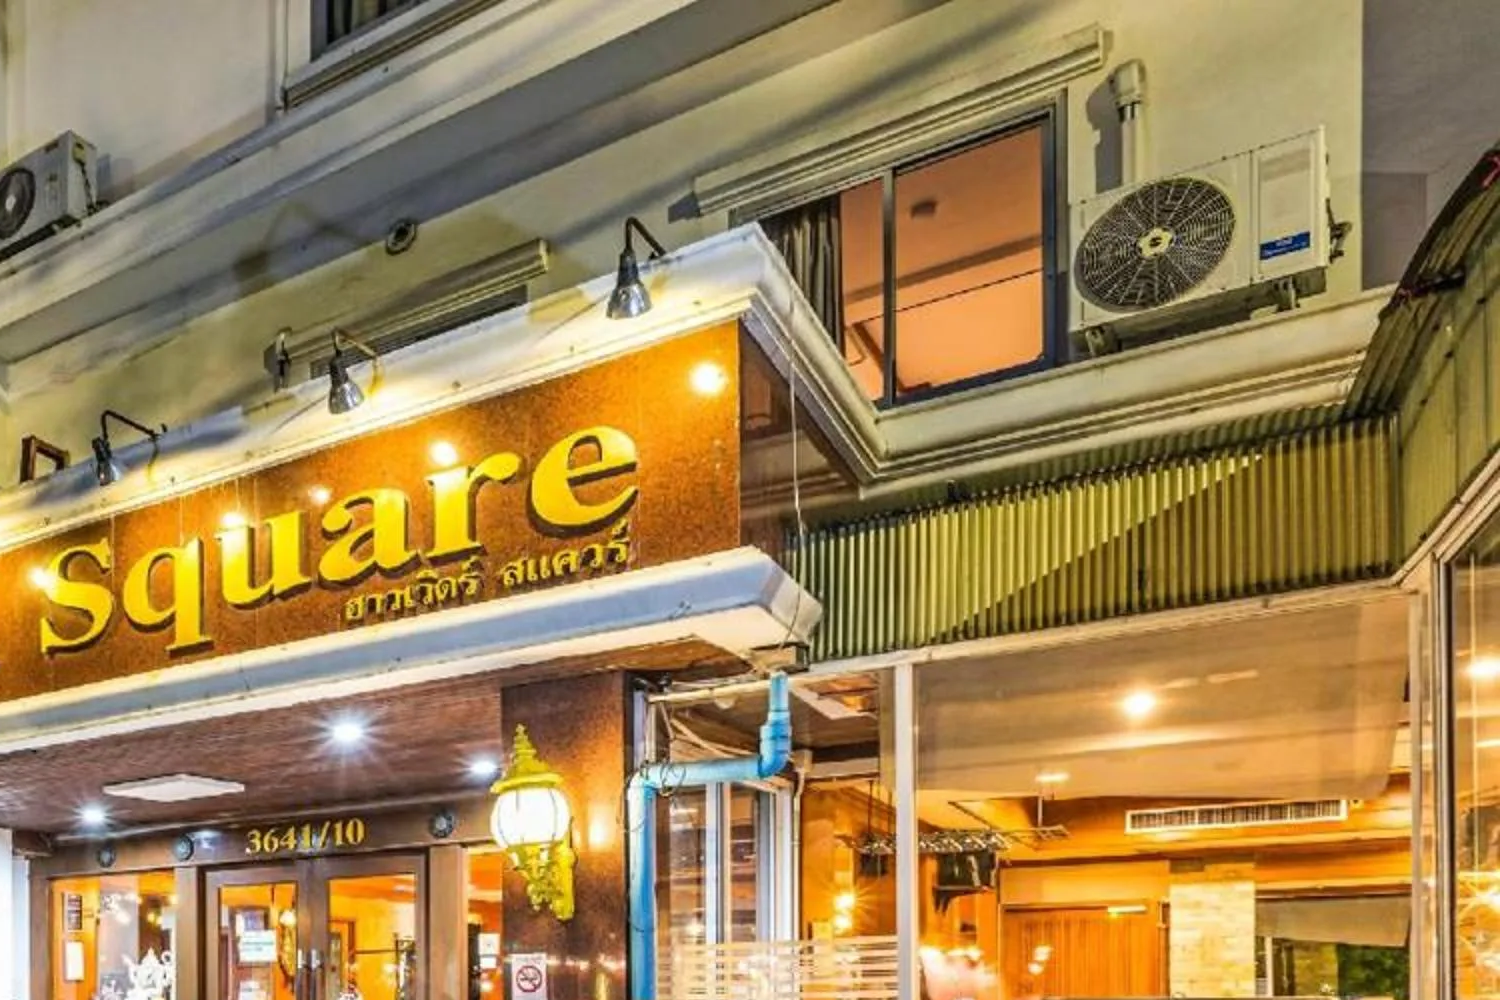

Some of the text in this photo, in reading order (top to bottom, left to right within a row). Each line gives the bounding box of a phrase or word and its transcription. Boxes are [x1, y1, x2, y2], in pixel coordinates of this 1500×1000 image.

[40, 425, 638, 654] Square
[502, 516, 630, 587] สแควร์
[245, 818, 366, 854] 3641/10
